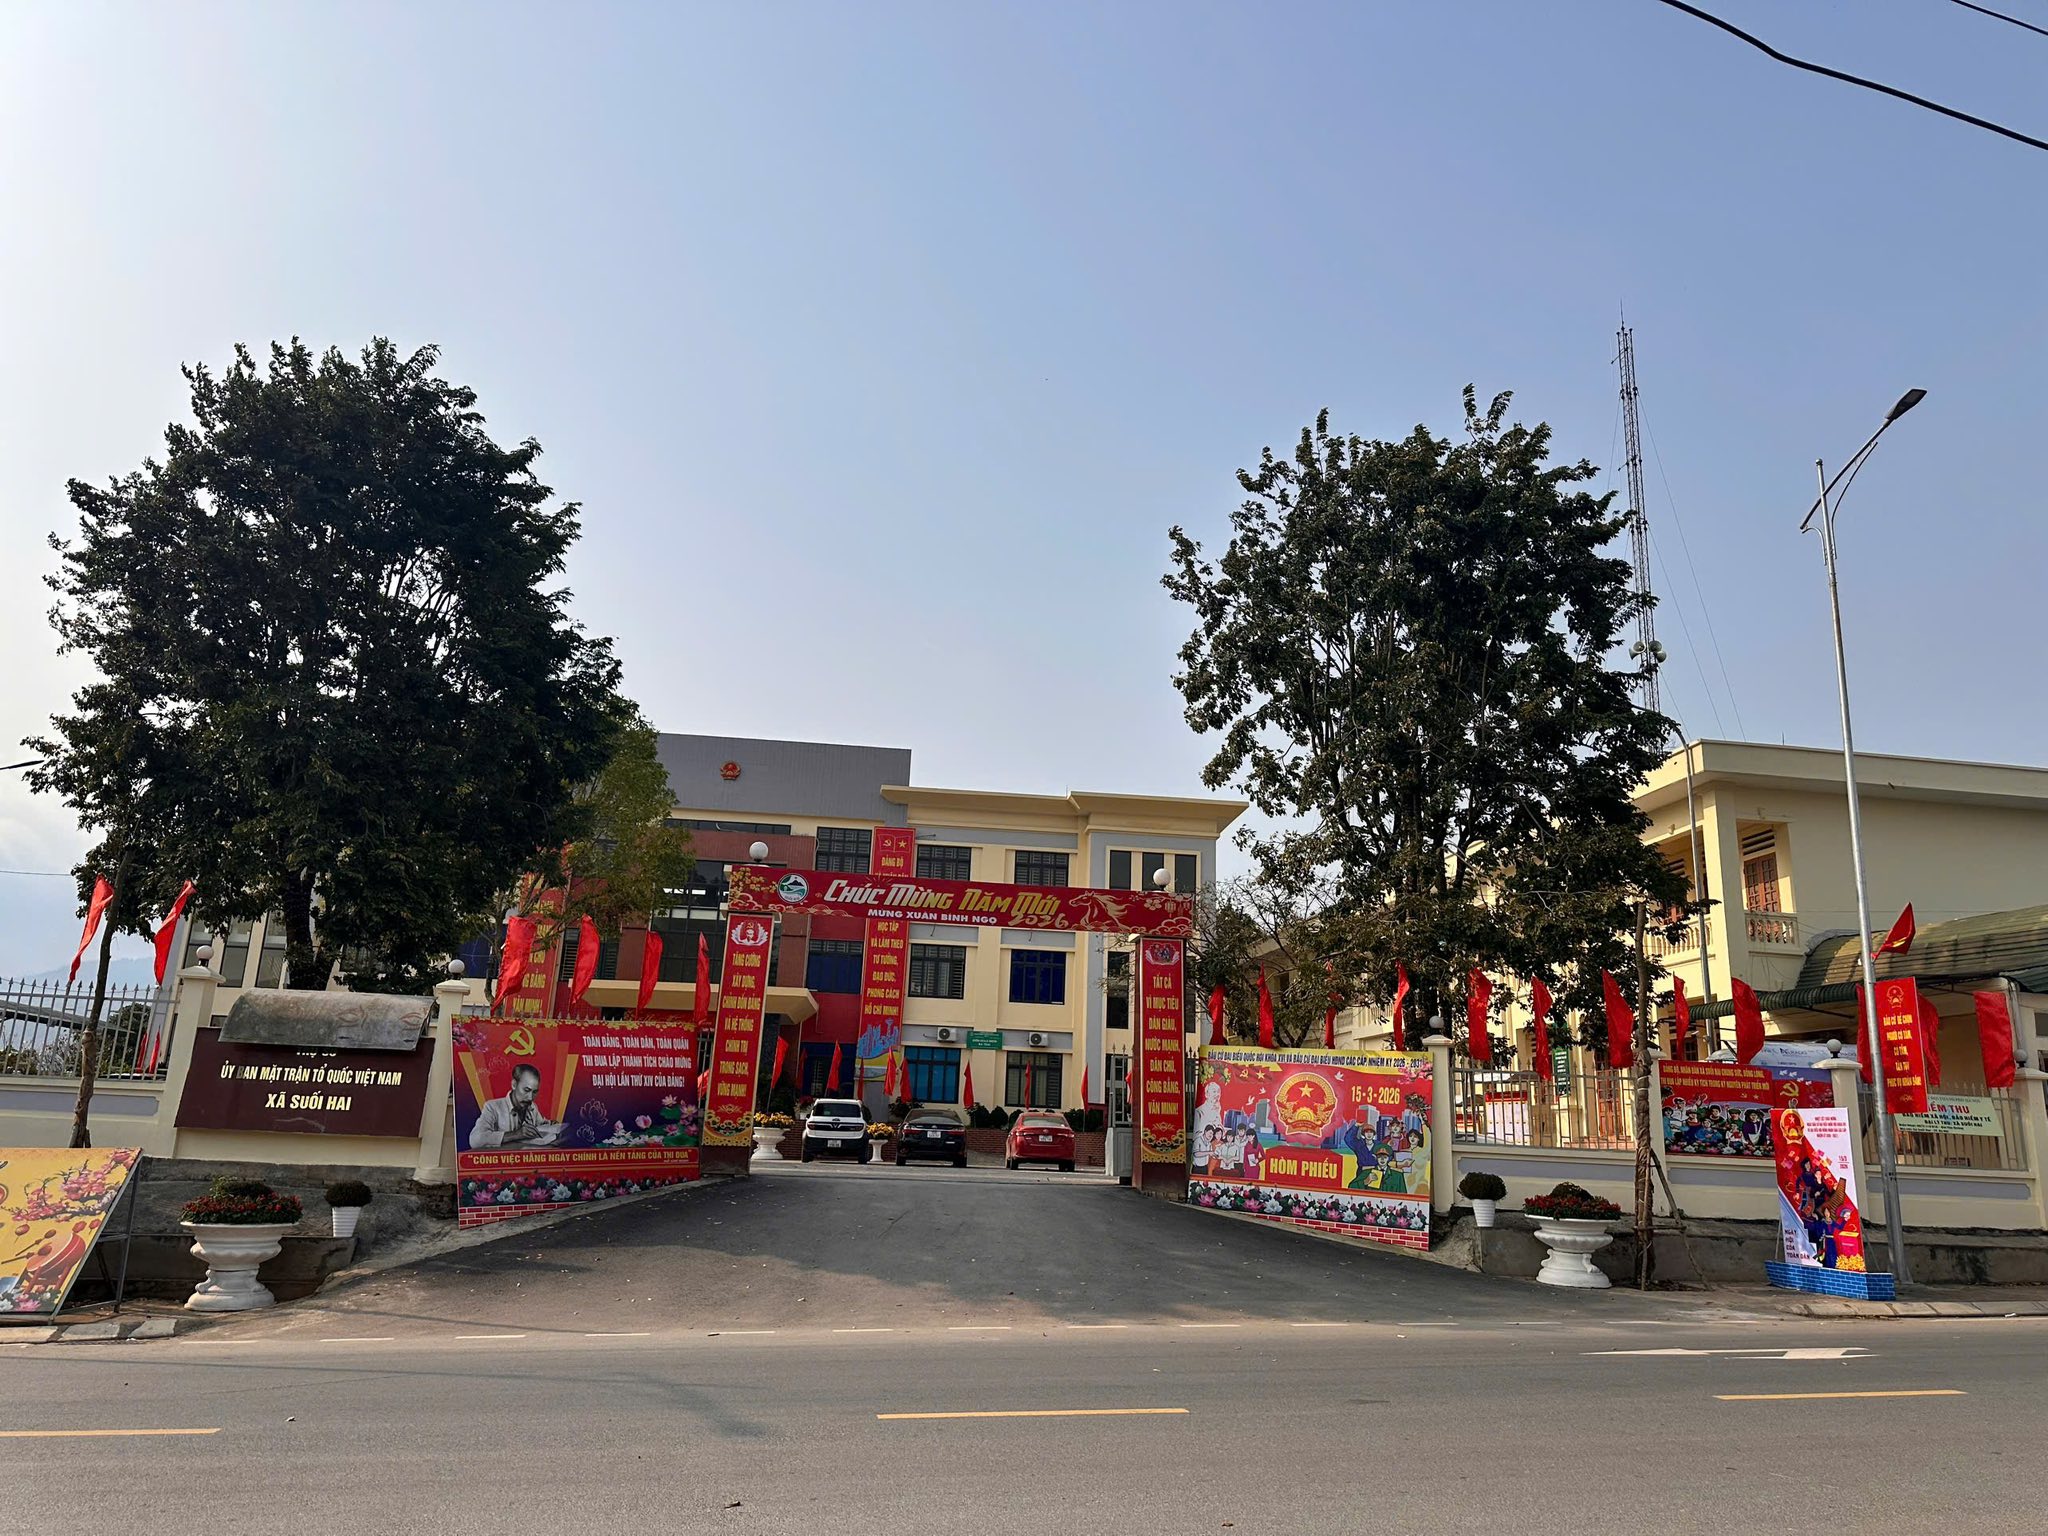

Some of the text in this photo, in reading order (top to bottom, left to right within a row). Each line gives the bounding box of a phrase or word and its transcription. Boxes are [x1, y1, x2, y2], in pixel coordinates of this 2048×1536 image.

[582, 1034, 600, 1047] TOÀN
[622, 1035, 640, 1049] TOÀN
[656, 1036, 672, 1049] TOÀN
[673, 1036, 689, 1051] QUÂN
[582, 1055, 593, 1066] THI
[594, 1055, 608, 1067] ĐUA
[608, 1053, 621, 1069] LẬP
[622, 1053, 642, 1067] THÀNH
[643, 1054, 657, 1068] TÍCH
[658, 1054, 674, 1068] CHÀO
[220, 1060, 402, 1087] ỦY BAN MẶT TRẬN TỔ QUỐC VIỆT NAM
[592, 1075, 604, 1088] ĐẠI
[605, 1072, 617, 1089] HỘI
[618, 1071, 630, 1086] LẦN
[630, 1073, 644, 1086] THỨ
[644, 1075, 654, 1087] XIV
[654, 1072, 667, 1087] CỦA
[265, 1090, 352, 1111] XÃ SUỐI HAI
[1928, 1101, 1970, 1114] IỂM THU
[501, 1154, 520, 1165] VIỆC
[548, 1152, 570, 1162] NGÀY
[572, 1151, 597, 1162] CHÍNH
[599, 1151, 608, 1160] LÀ
[610, 1150, 626, 1160] NỀN
[647, 1149, 661, 1159] CỦA
[663, 1151, 674, 1159] THI
[1269, 1153, 1338, 1179] HÒM PHIẾU
